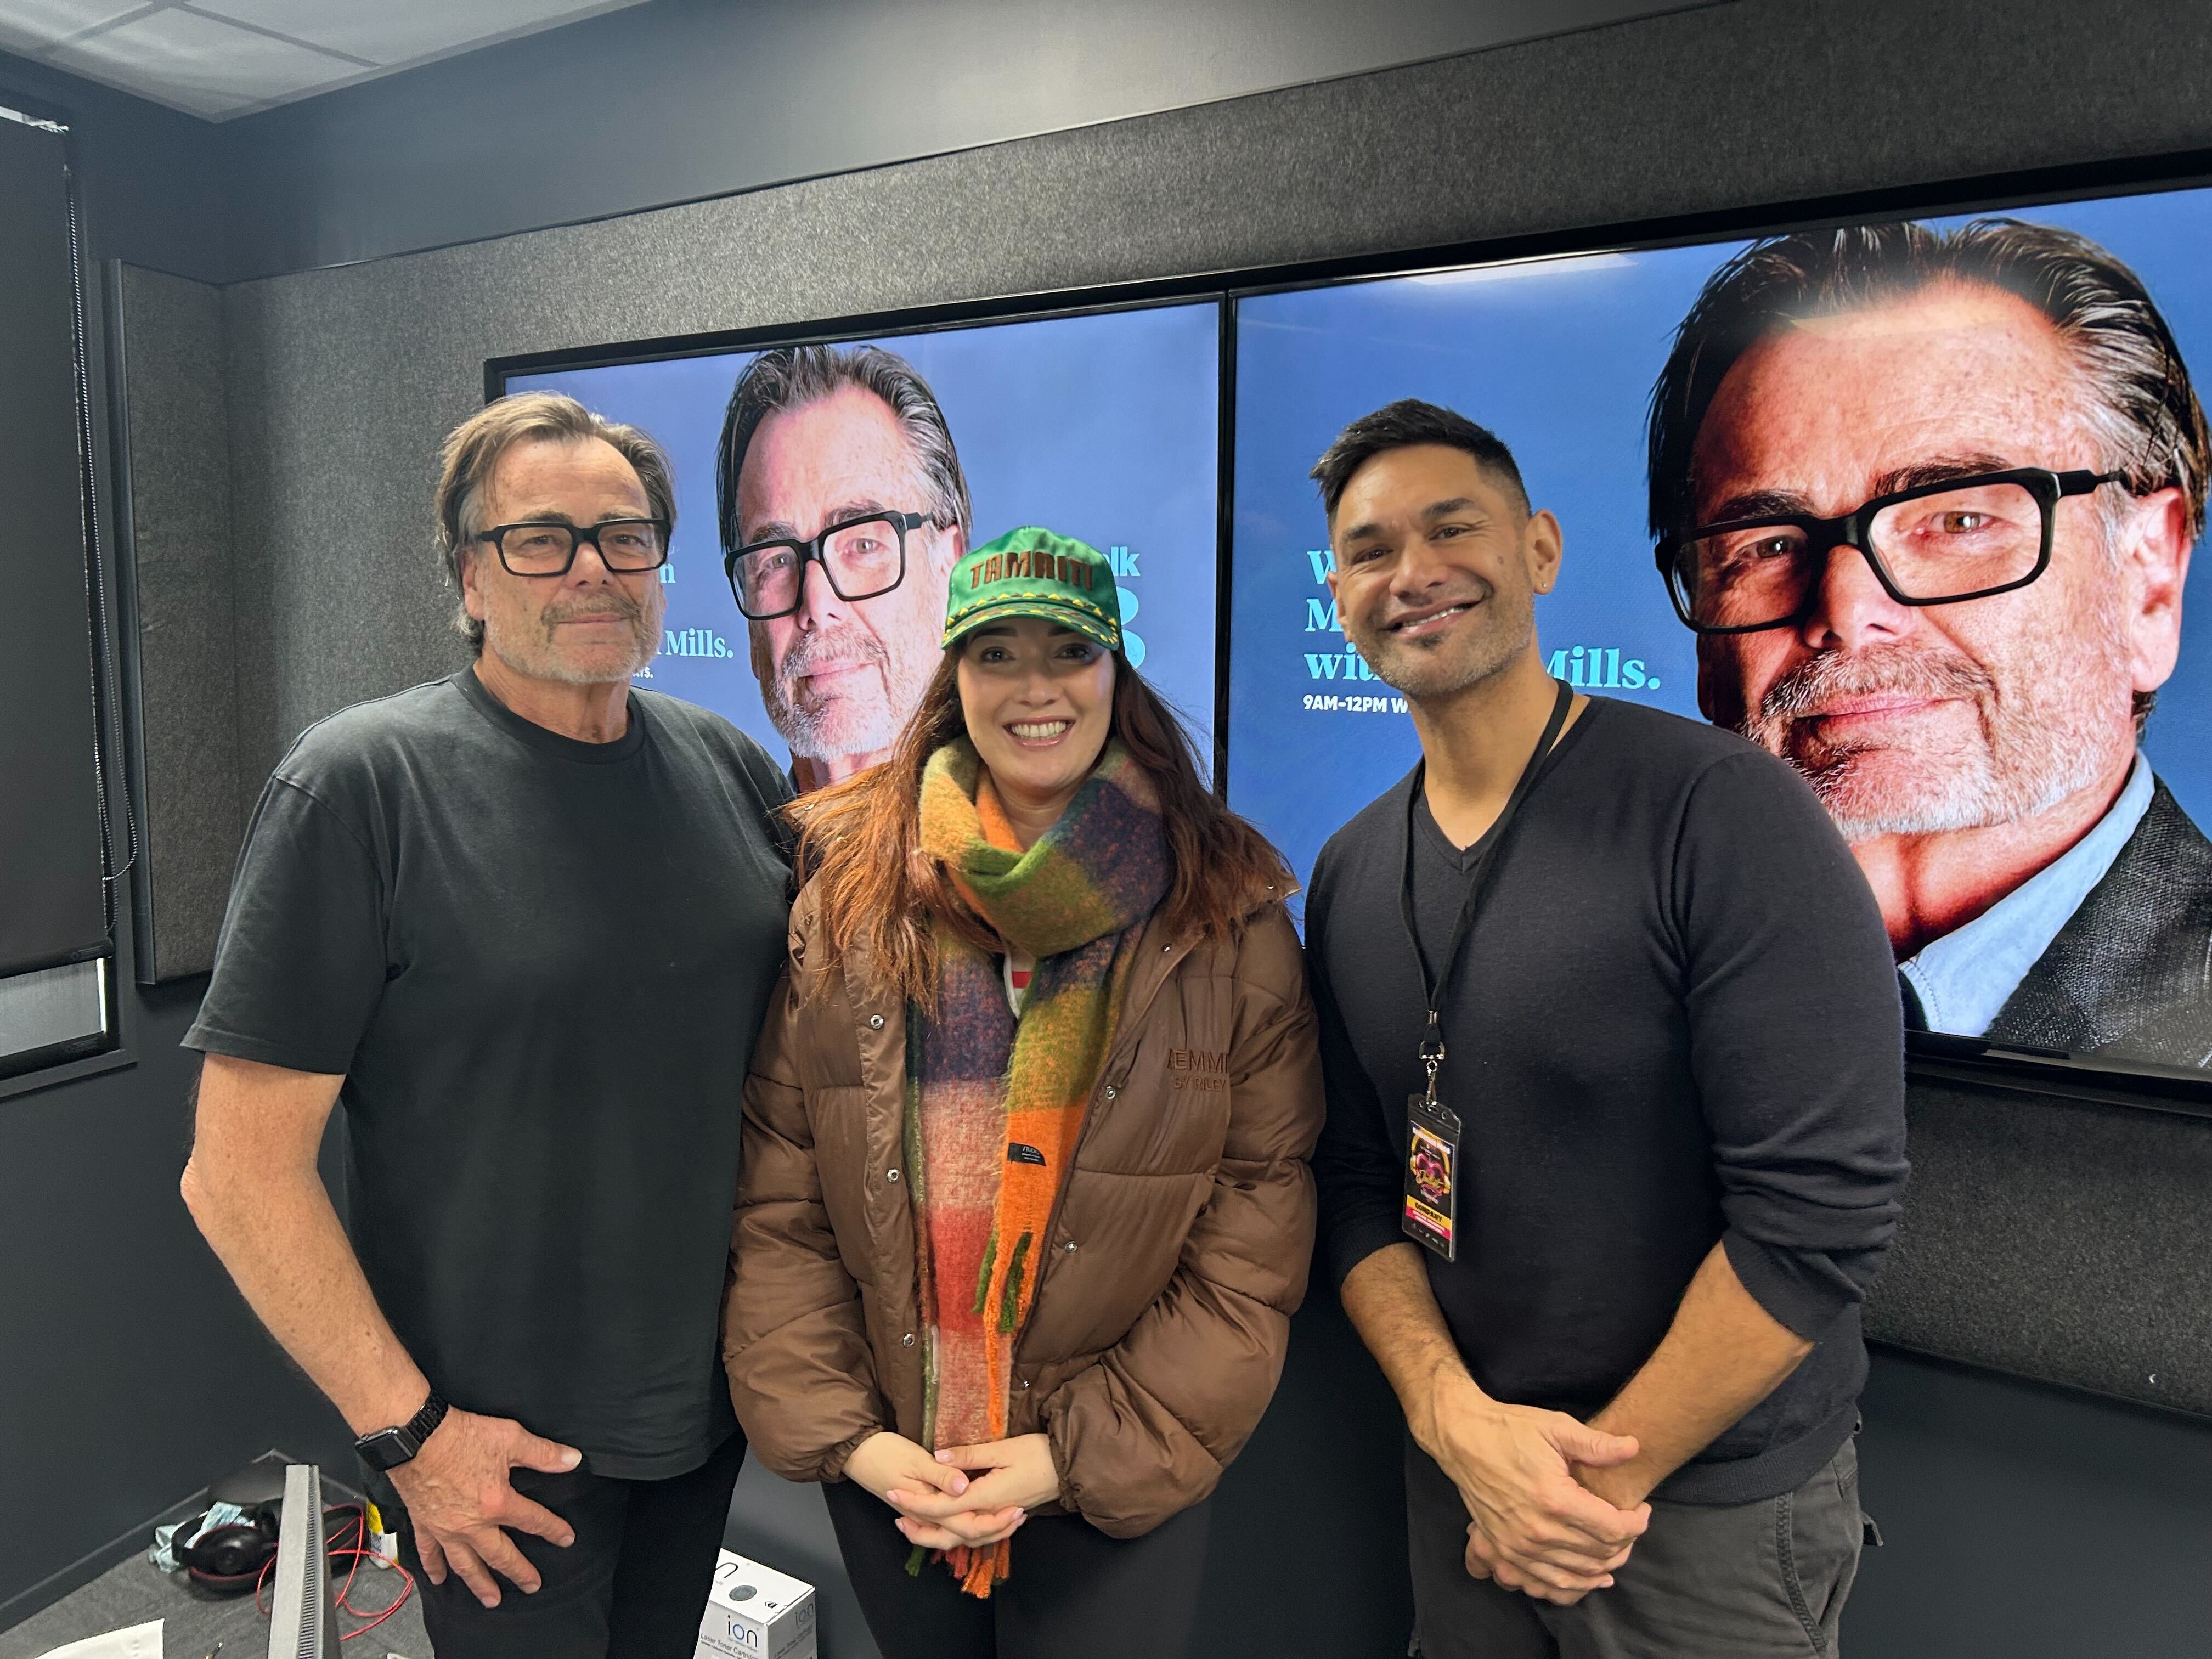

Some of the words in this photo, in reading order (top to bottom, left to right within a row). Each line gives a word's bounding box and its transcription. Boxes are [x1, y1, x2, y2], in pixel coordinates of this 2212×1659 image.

[665, 627, 733, 658] Mills.
[1304, 642, 1383, 681] wit
[1303, 695, 1387, 713] 9AM-12PM
[727, 1615, 757, 1648] ion
